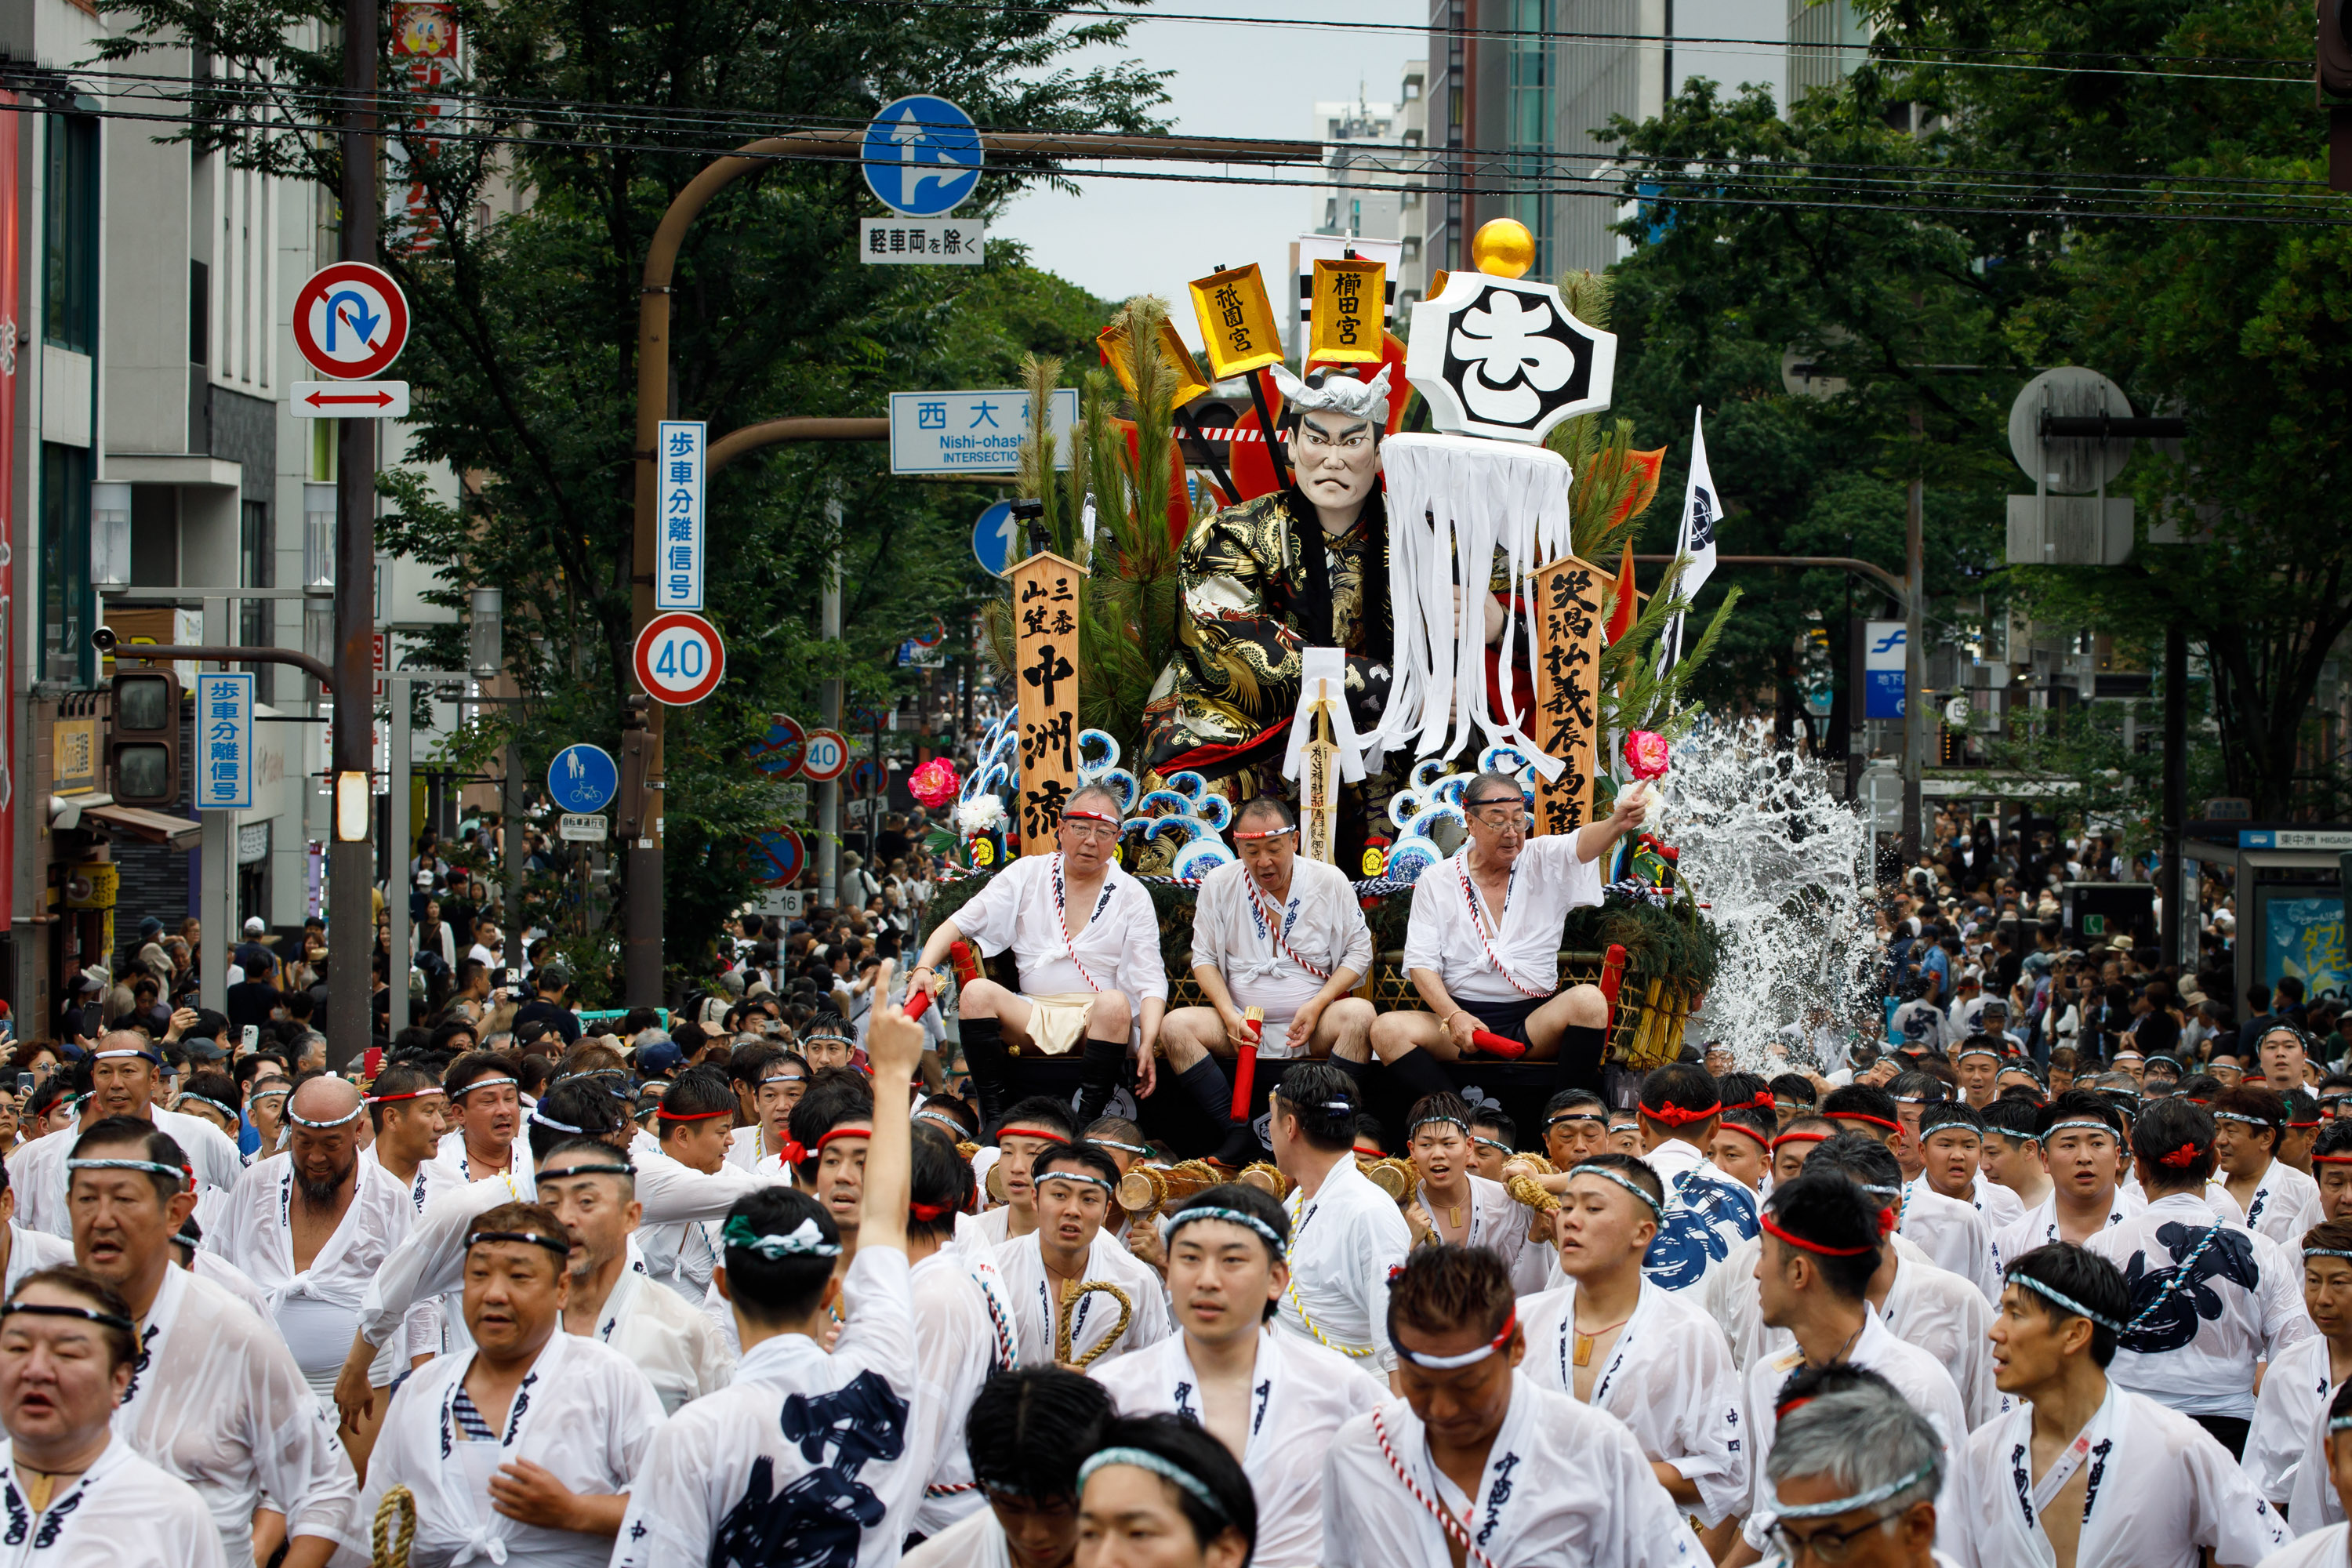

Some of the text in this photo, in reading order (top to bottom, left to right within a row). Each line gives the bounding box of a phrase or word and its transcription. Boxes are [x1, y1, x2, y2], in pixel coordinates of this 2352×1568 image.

[869, 229, 977, 256] 軽車両を除く
[1214, 283, 1253, 353] 祇園宮
[1332, 272, 1362, 346] 櫛田宮
[944, 452, 1018, 463] INTERSECTIO
[668, 431, 695, 600] 歩車分離信号
[1021, 580, 1051, 640] 山笠
[1050, 578, 1076, 636] 三番
[655, 639, 704, 679] 40
[1877, 673, 1906, 686] 地下
[210, 681, 240, 801] 歩車分離信号
[808, 743, 837, 766] 40
[1022, 644, 1075, 840] 中洲流
[562, 818, 606, 828] 自転車通行可
[2281, 833, 2316, 846] 東中洲
[758, 895, 797, 912] 2-16
[1726, 1408, 1741, 1453] 中四
